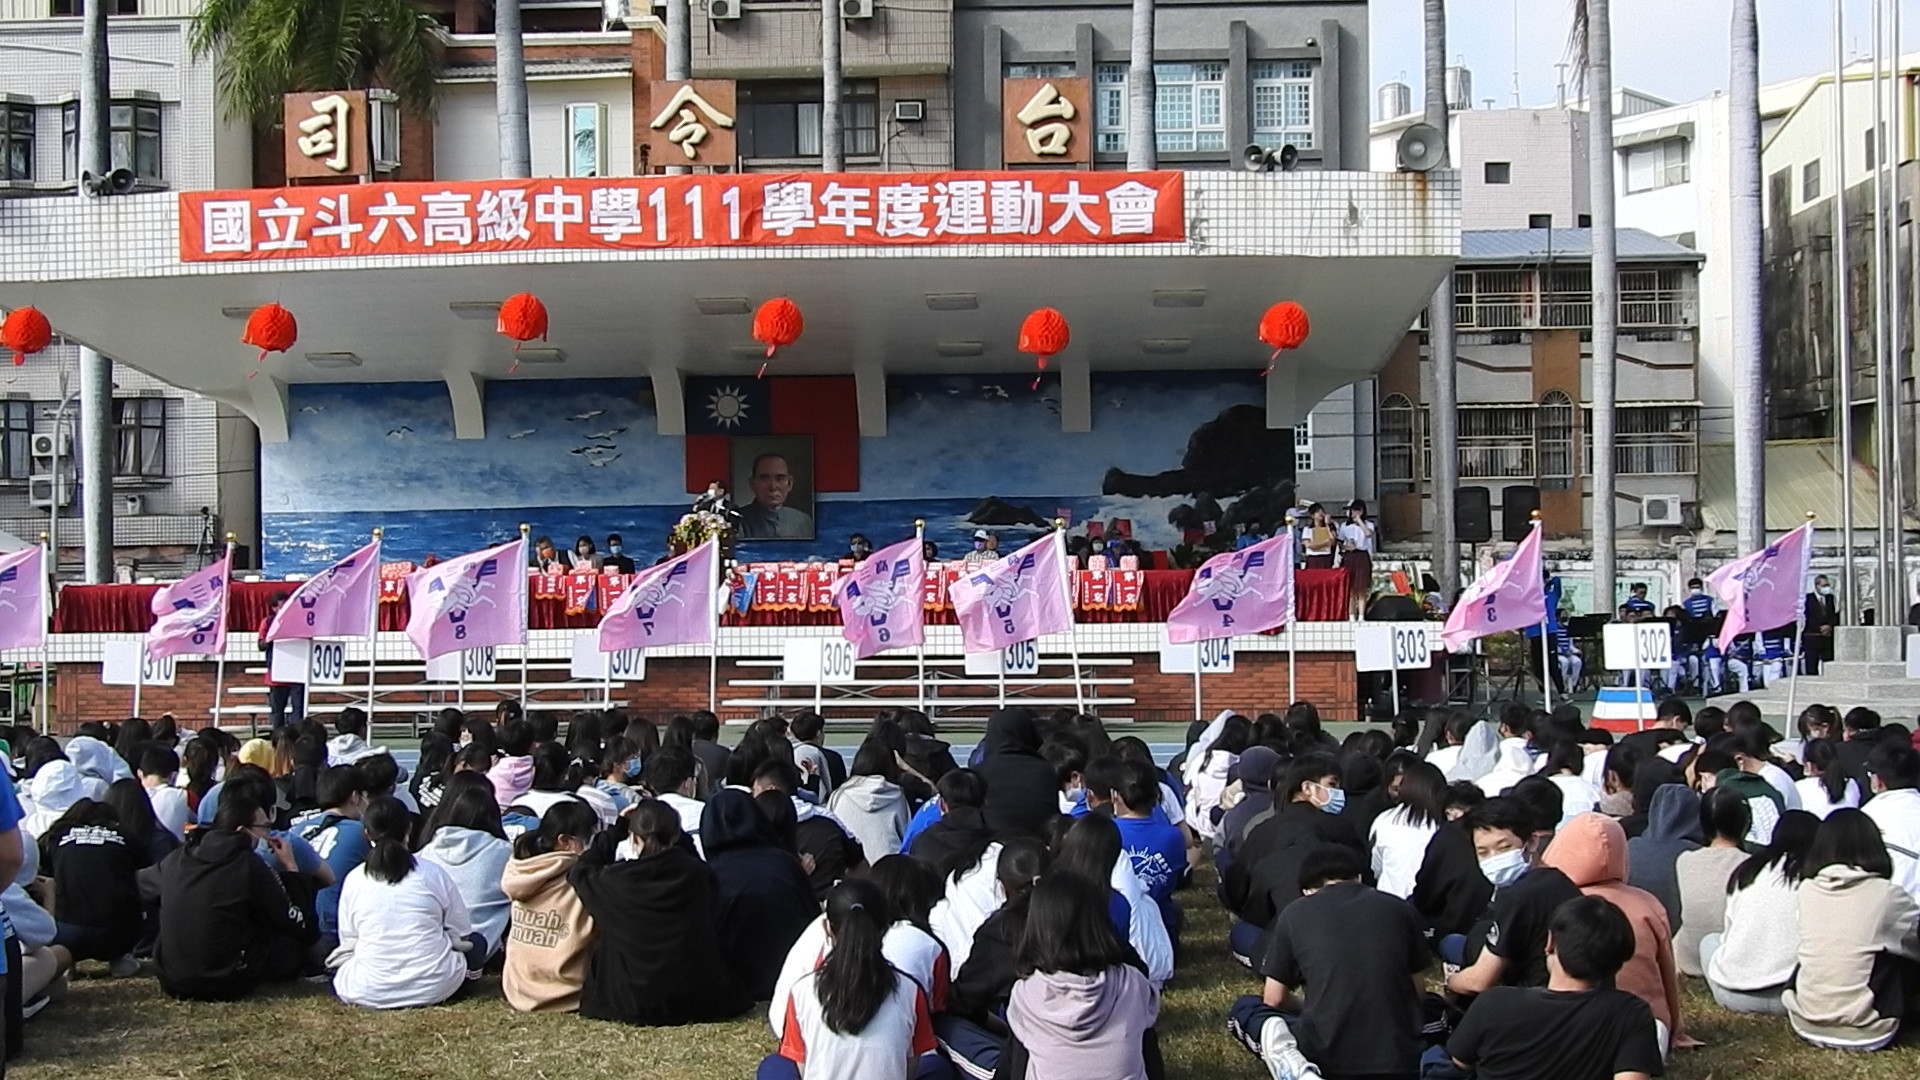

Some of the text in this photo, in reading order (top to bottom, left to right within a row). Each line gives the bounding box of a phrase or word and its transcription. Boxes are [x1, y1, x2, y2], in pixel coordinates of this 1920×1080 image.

[298, 95, 349, 171] 司
[650, 84, 734, 159] 令
[1017, 82, 1076, 155] 台
[465, 646, 493, 675] 308
[823, 642, 851, 676] 306
[1005, 639, 1035, 669] 305
[1201, 637, 1231, 667] 304
[1397, 629, 1426, 663] 303
[1640, 632, 1667, 662] 302
[313, 644, 342, 679] 309
[612, 649, 640, 675] 307
[1153, 852, 1173, 874] BEST
[513, 905, 561, 930] muah
[512, 924, 559, 949] muah
